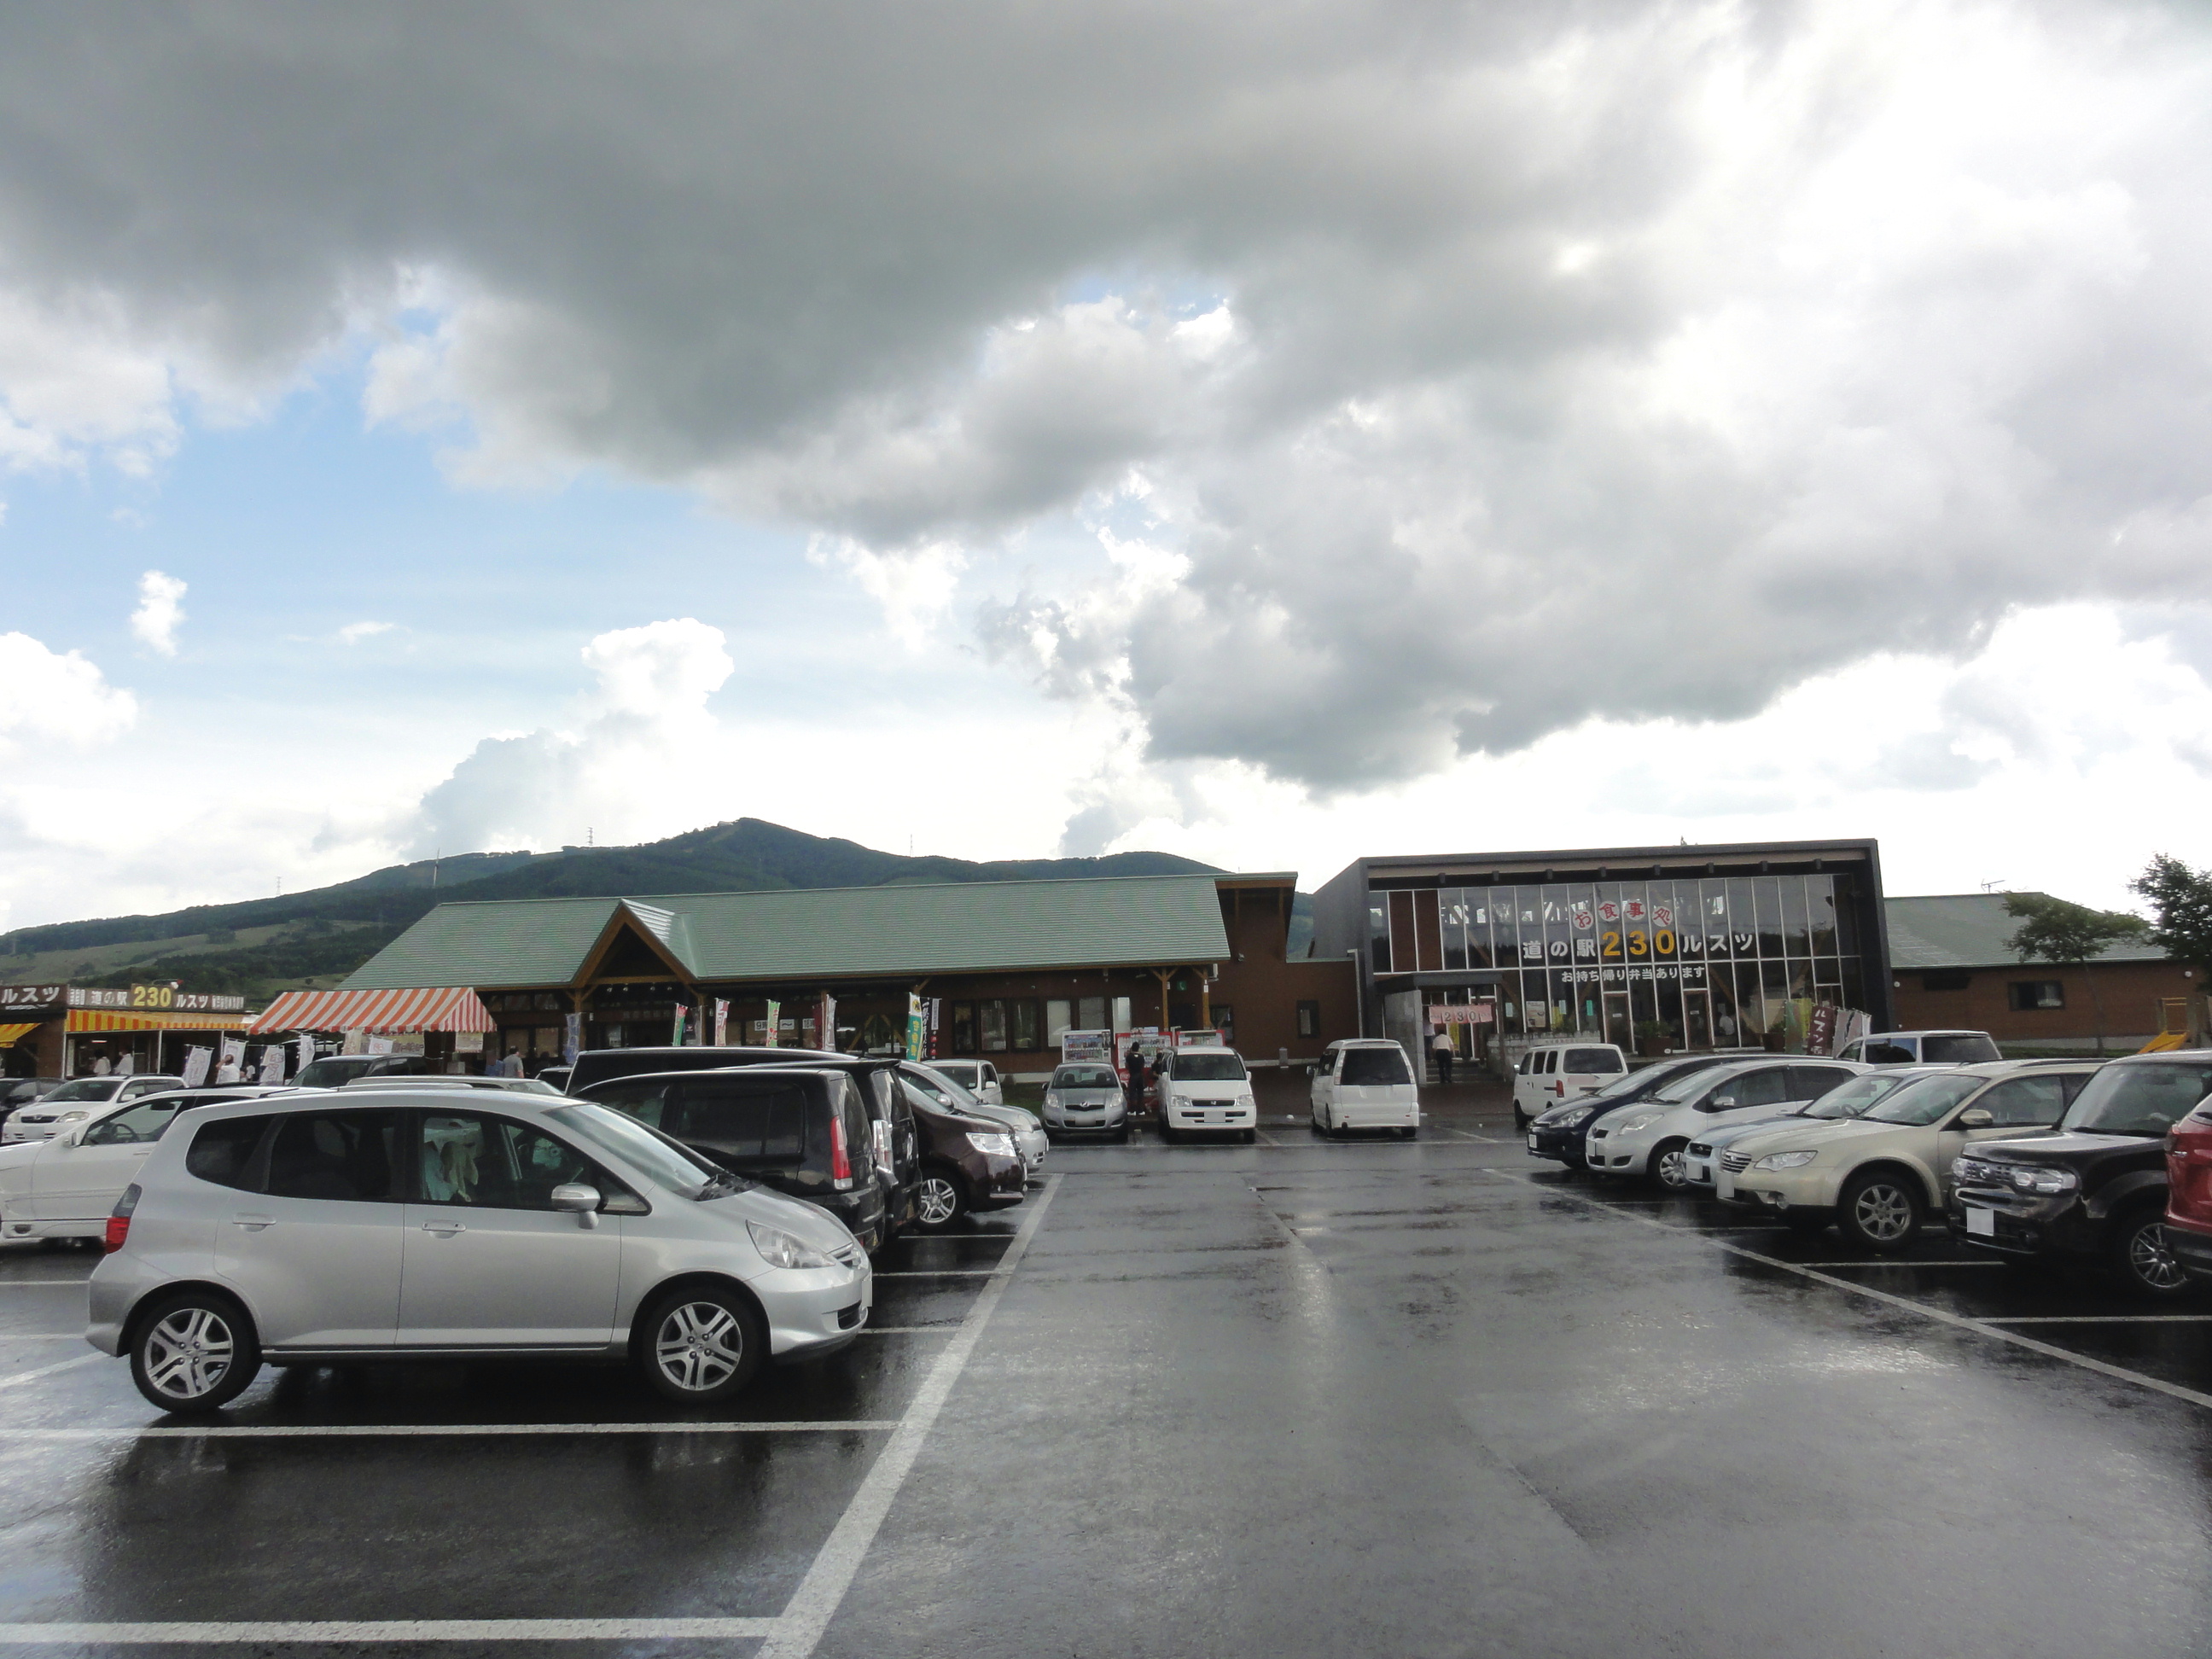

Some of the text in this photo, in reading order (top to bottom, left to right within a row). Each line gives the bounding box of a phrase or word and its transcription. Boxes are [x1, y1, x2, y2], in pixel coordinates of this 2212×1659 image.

[1575, 901, 1672, 928] お食事処
[1562, 966, 1705, 983] お持ち帰り弁当あります
[1, 987, 60, 1004] ルスツ
[1444, 1010, 1476, 1022] 230
